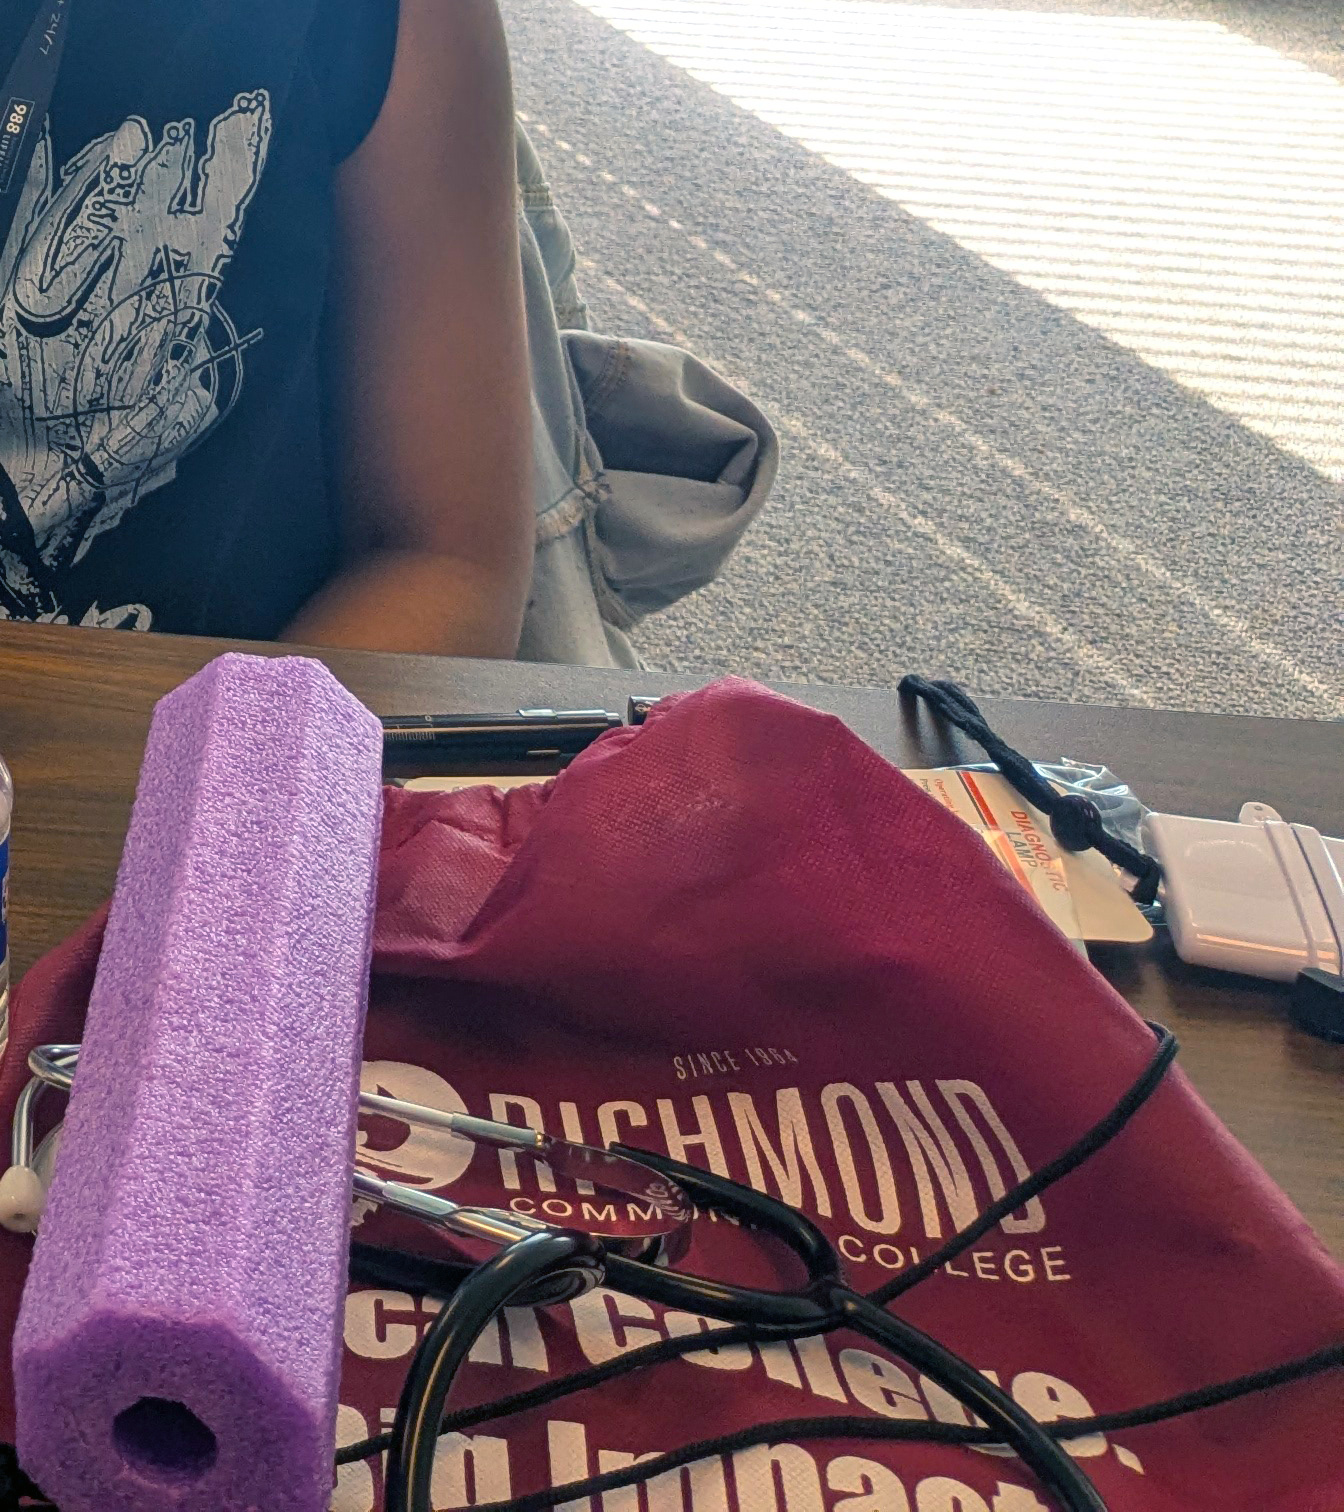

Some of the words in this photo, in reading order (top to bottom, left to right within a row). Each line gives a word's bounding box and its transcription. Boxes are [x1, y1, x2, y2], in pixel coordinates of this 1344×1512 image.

[6, 103, 27, 134] 988
[1006, 831, 1038, 869] LAMP
[673, 1049, 741, 1081] SINCE
[744, 1046, 801, 1074] 1964
[489, 1077, 1047, 1238] RICHMOND
